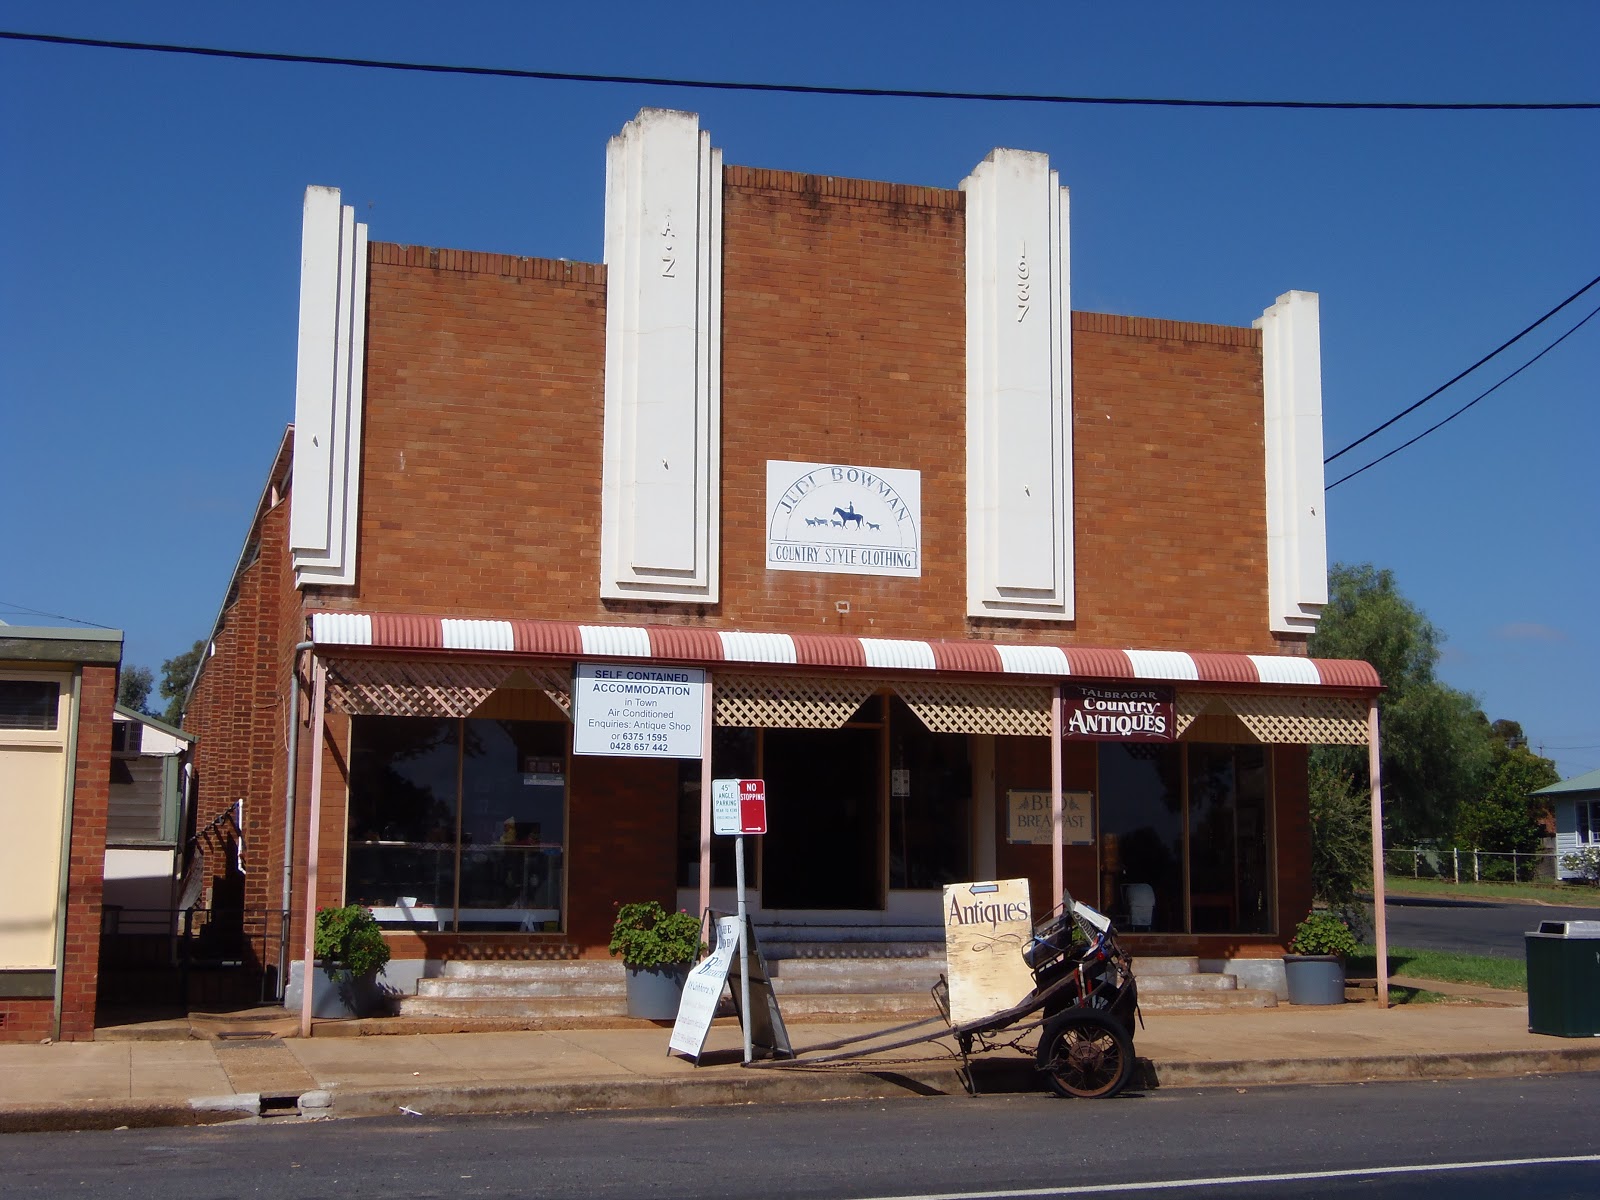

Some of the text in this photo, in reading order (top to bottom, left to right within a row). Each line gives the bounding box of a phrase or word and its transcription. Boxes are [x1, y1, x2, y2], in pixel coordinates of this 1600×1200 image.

[1017, 238, 1030, 323] 1937
[780, 467, 909, 522] JUDI BOWMAN
[775, 545, 911, 567] COUNTRY STYLE CLOTHING
[594, 669, 689, 683] SELF CONTAINED
[592, 683, 691, 696] ACCOMMODATION
[1081, 687, 1158, 700] TALBRAGAR
[624, 698, 658, 707] in Town
[1083, 697, 1161, 715] Country
[607, 708, 674, 719] Air Conditioned
[588, 718, 692, 732] Enquiries: Antique Shop
[1068, 708, 1167, 736] ANTIQUES
[611, 732, 668, 742] or 6375 1595
[609, 742, 668, 752] 0428 657 442
[746, 783, 757, 791] NO
[740, 793, 764, 801] STOPPING
[1017, 814, 1085, 828] BREAAST
[948, 893, 1029, 933] Antiques
